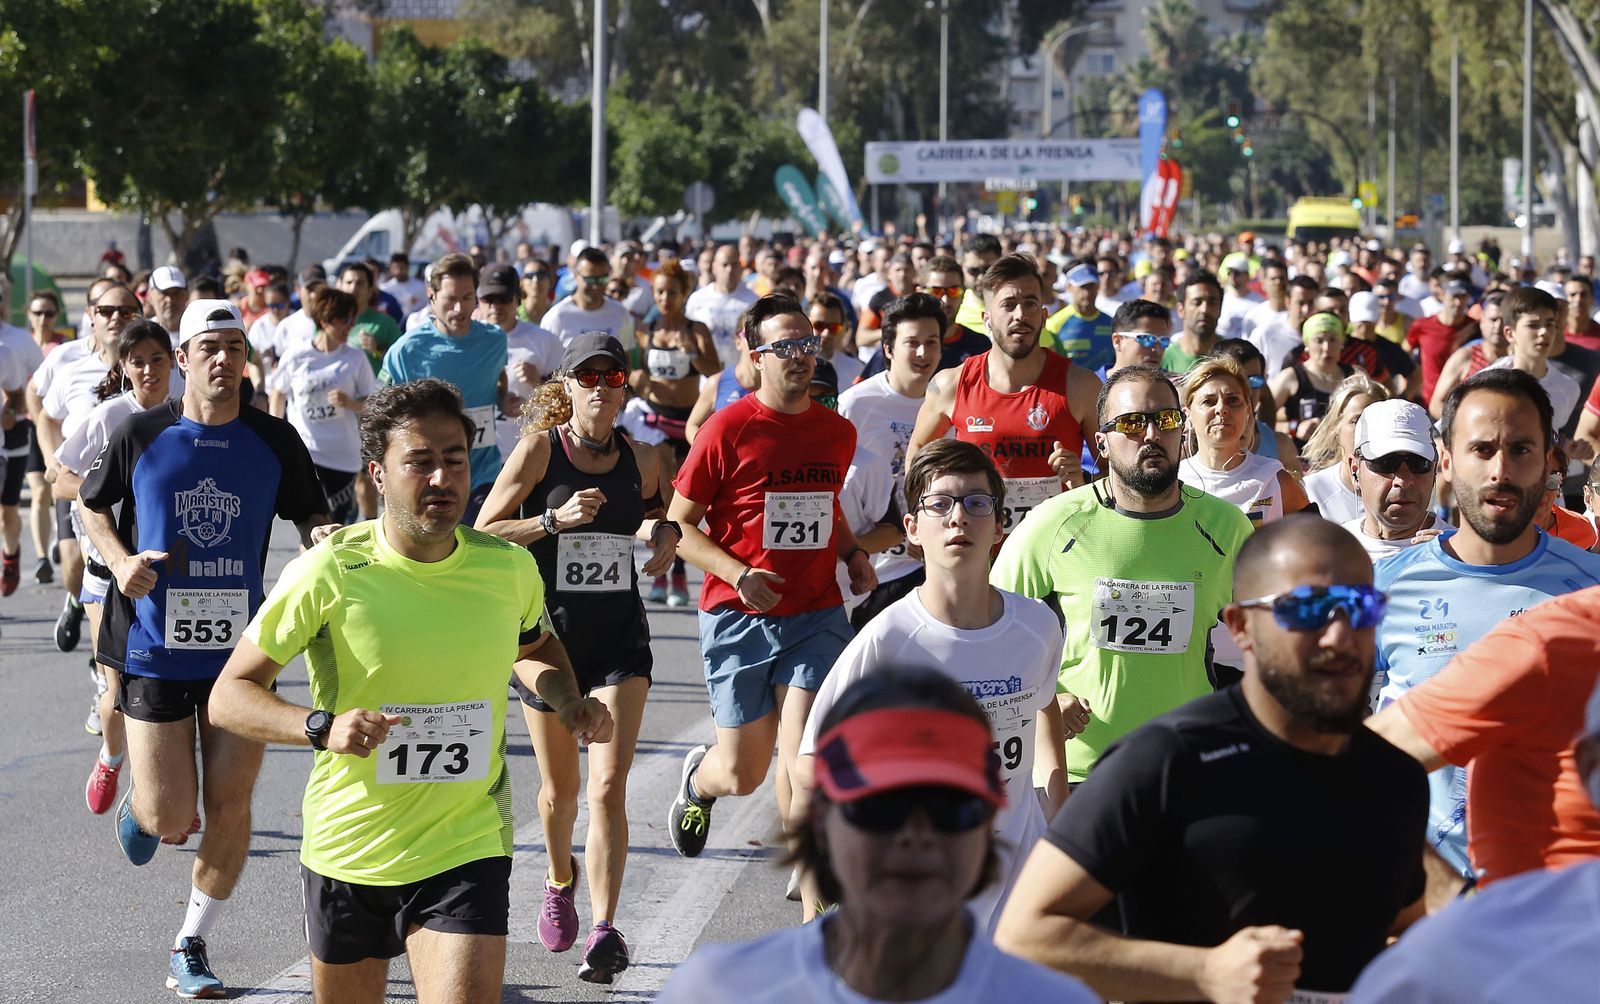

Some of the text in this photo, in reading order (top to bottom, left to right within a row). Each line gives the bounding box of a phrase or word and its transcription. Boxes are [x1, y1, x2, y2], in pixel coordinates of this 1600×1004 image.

[917, 146, 985, 161] CARRERA
[990, 146, 1009, 160] DE
[1012, 145, 1033, 159] LA
[1036, 144, 1095, 159] PRENSA
[306, 405, 337, 420] 232
[175, 492, 241, 517] MARISTAS
[771, 521, 819, 543] 731
[565, 562, 620, 585] 824
[1107, 581, 1139, 590] CARRERA
[173, 619, 232, 643] 553
[1100, 615, 1172, 646] 124
[445, 705, 455, 713] LA
[456, 703, 485, 712] PRENSA
[987, 701, 998, 709] DE
[998, 699, 1008, 707] LA
[1009, 692, 1033, 705] PRENSA
[388, 742, 470, 775] 173
